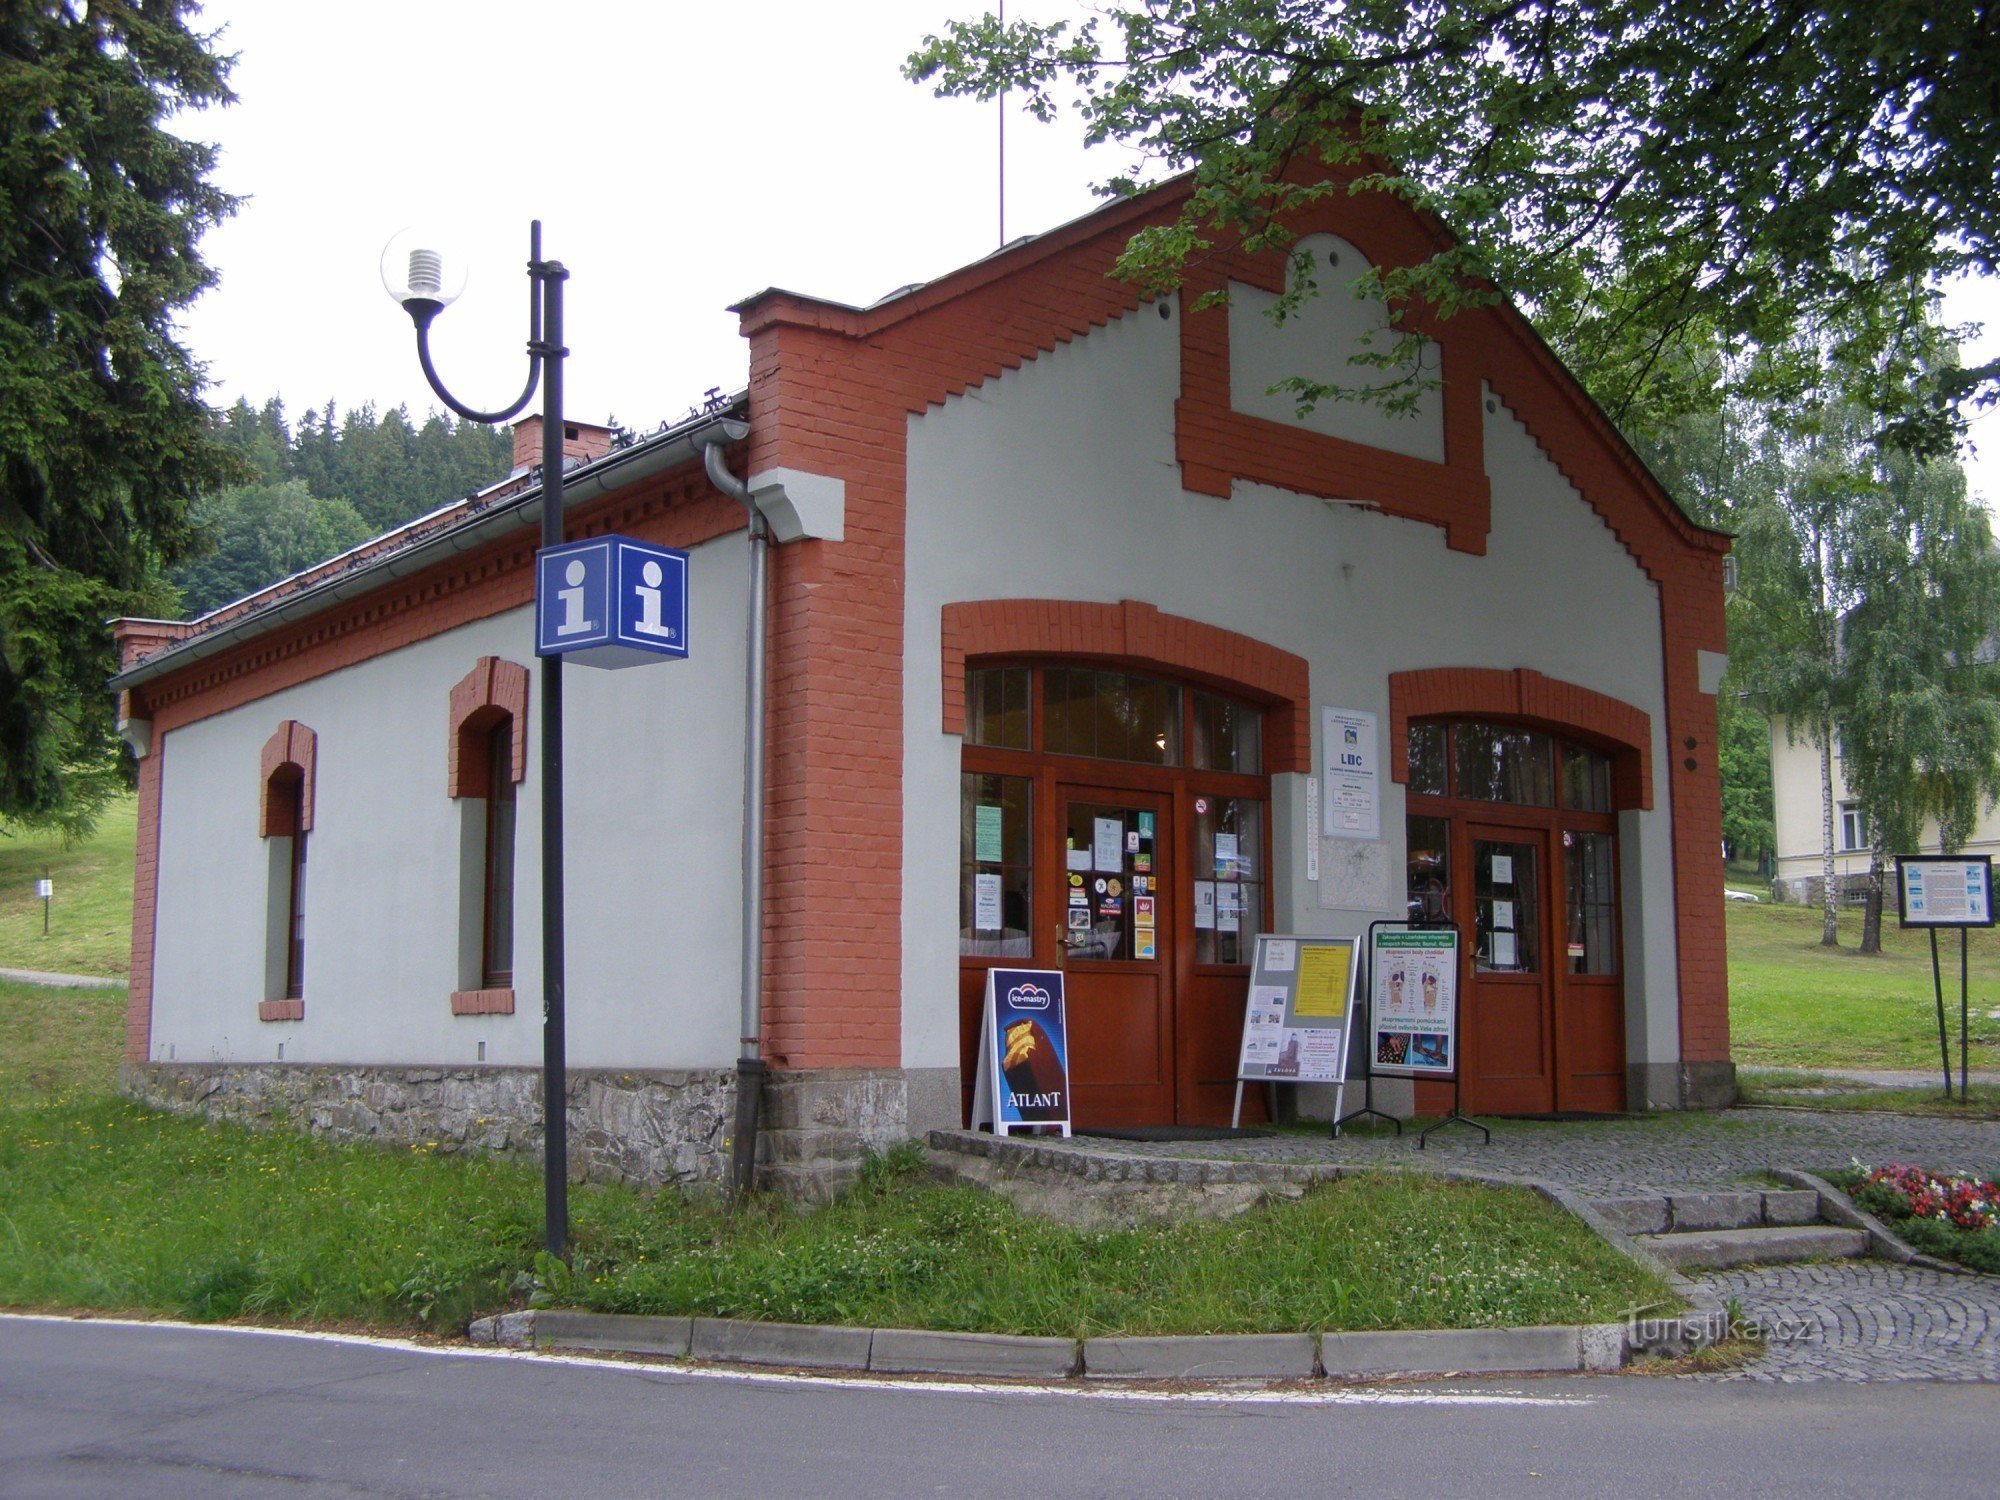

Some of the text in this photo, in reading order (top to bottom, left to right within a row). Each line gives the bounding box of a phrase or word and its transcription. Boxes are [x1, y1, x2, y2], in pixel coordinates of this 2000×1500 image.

[635, 560, 669, 638] i
[1412, 949, 1424, 957] body
[1007, 1091, 1061, 1108] ATLANT
